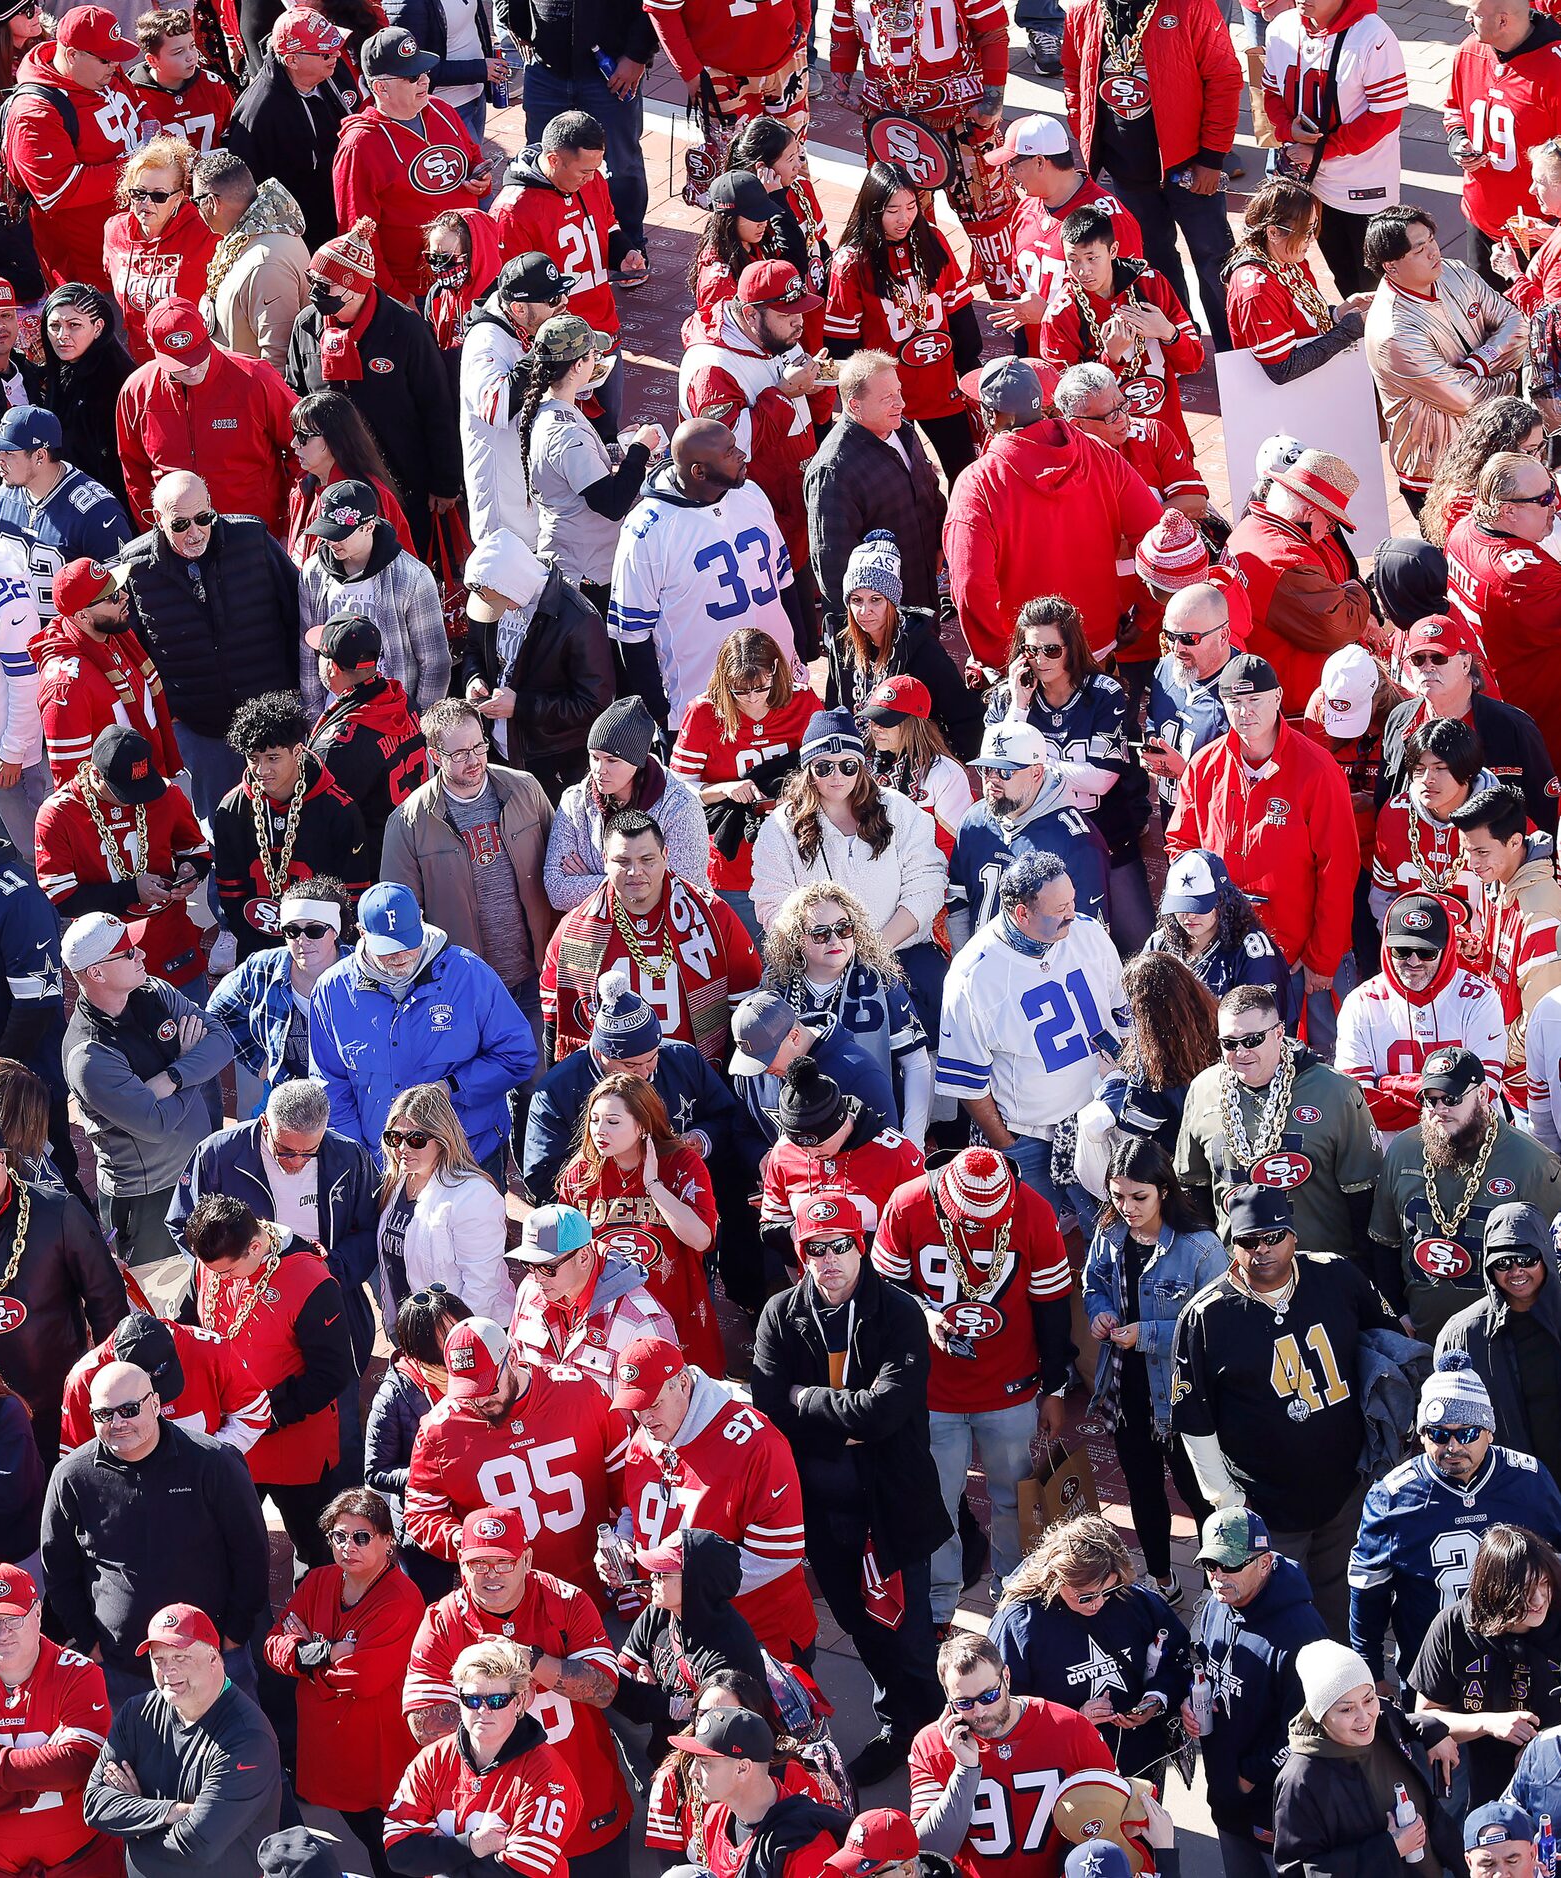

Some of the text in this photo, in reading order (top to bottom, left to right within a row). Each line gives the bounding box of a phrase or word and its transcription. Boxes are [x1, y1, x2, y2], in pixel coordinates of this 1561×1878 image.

[886, 124, 942, 186] SF
[1469, 99, 1516, 172] 19
[1095, 197, 1121, 217] 97
[559, 217, 609, 294] 21
[211, 418, 238, 430] 49ERS
[68, 479, 113, 515] 22
[693, 526, 777, 623] 33
[1057, 807, 1090, 835] 11
[386, 909, 397, 931] F
[670, 879, 718, 981] 49
[1244, 930, 1277, 960] 81
[428, 1005, 454, 1015] FORTUNA
[430, 1023, 452, 1032] FOOTBALL
[1022, 969, 1109, 1074] 21
[917, 1243, 1017, 1303] 97
[1269, 1322, 1350, 1416] 41
[721, 1406, 765, 1447] 97
[478, 1435, 585, 1524] 85
[527, 1797, 566, 1837] 16
[966, 1767, 1066, 1857] 97
